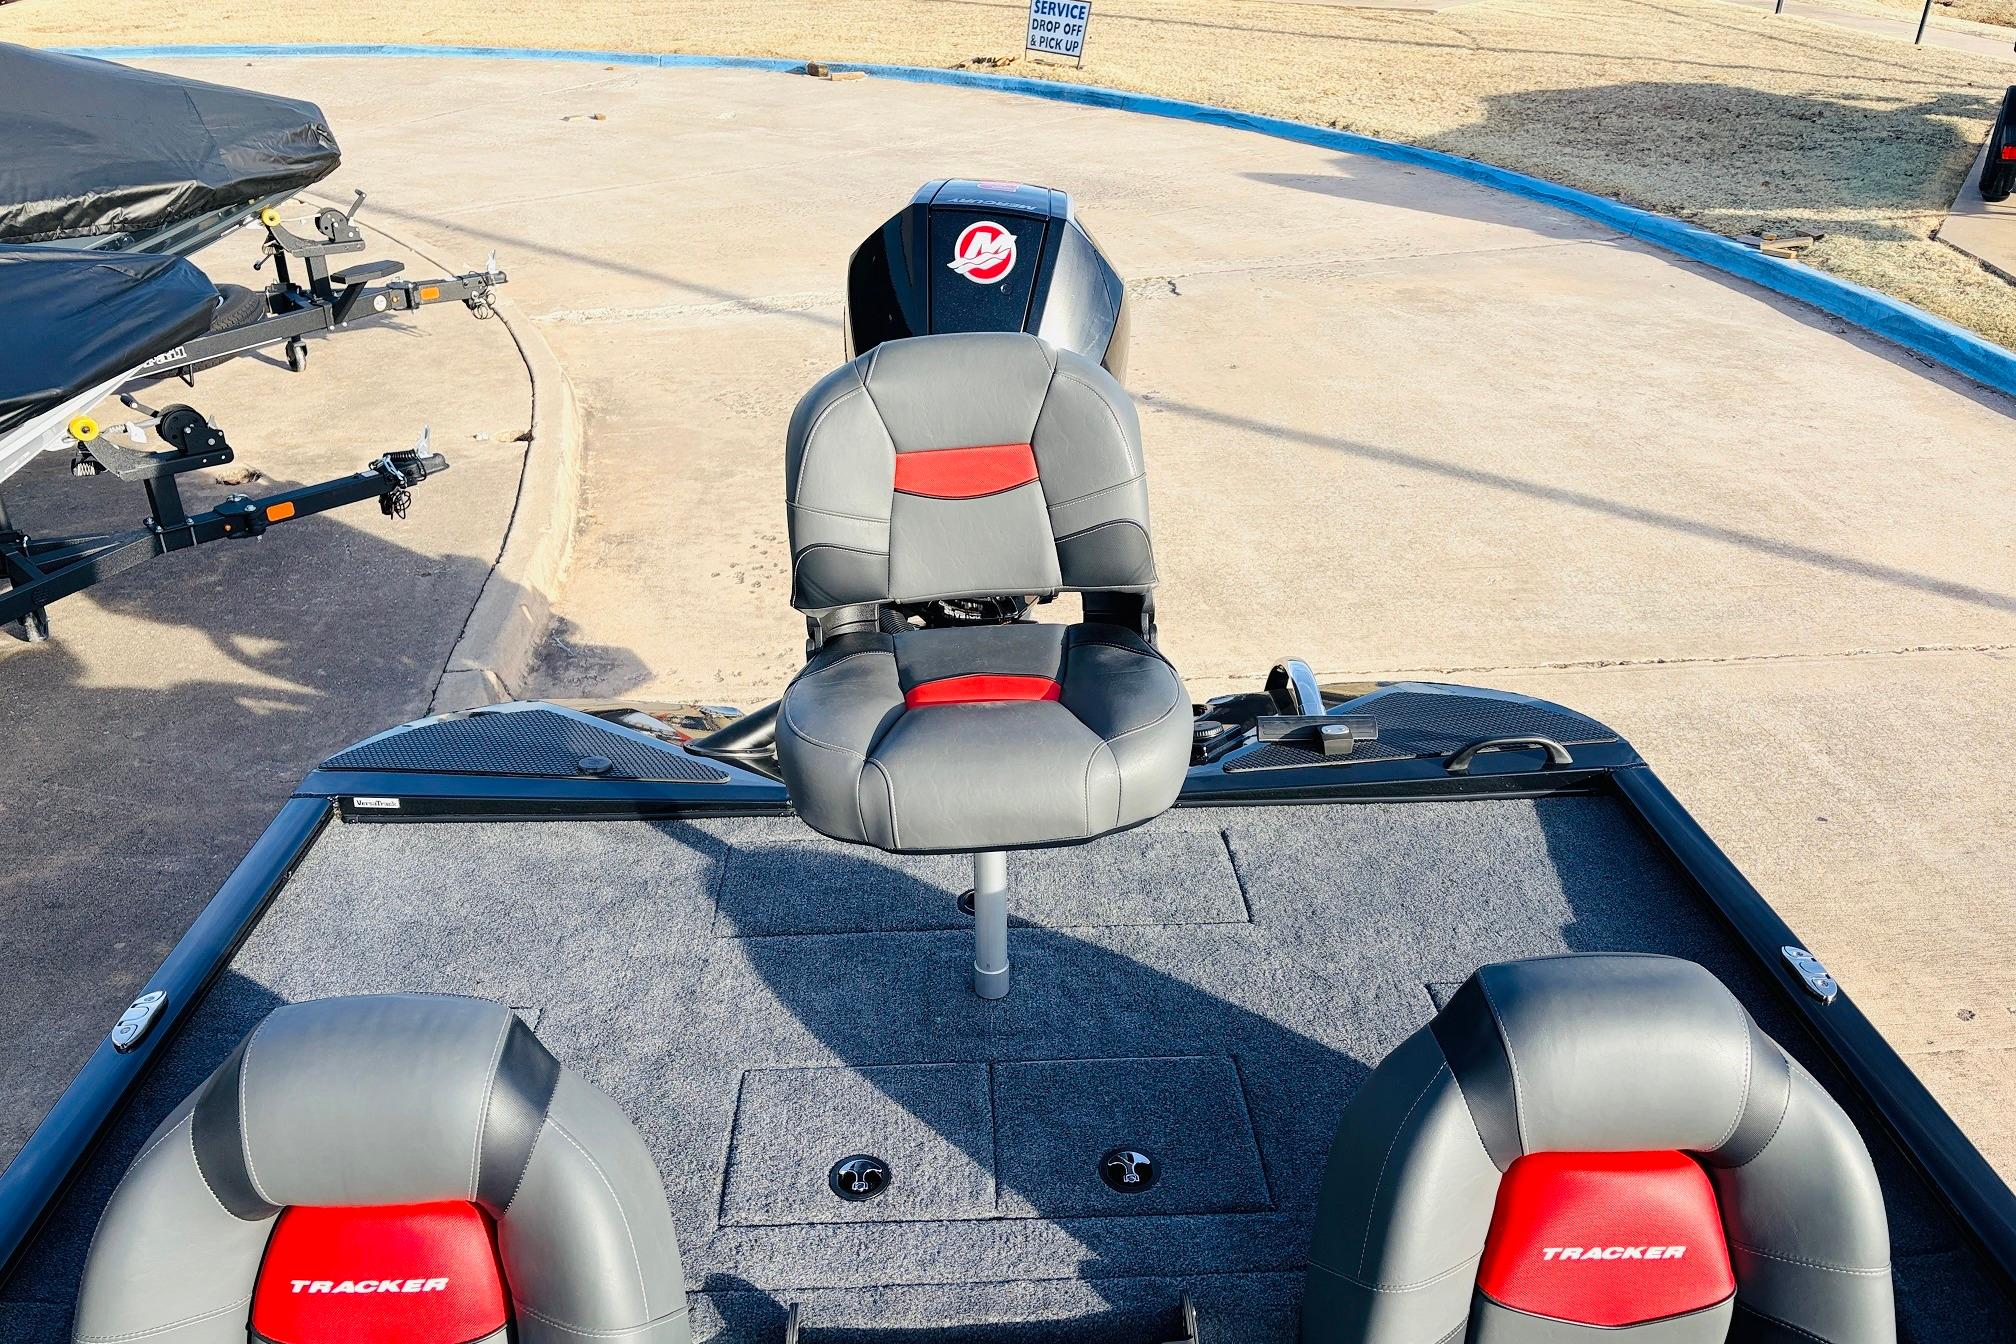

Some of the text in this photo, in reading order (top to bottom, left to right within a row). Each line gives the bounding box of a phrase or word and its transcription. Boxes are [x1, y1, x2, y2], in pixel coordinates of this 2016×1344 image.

[1034, 0, 1086, 20] SERVICE
[1032, 18, 1082, 36] DROP OFF
[1030, 34, 1079, 52] & PICK UP
[947, 199, 1037, 210] MERCURY
[1543, 1244, 1686, 1261] TRACKER
[291, 1278, 449, 1294] TRACKER
